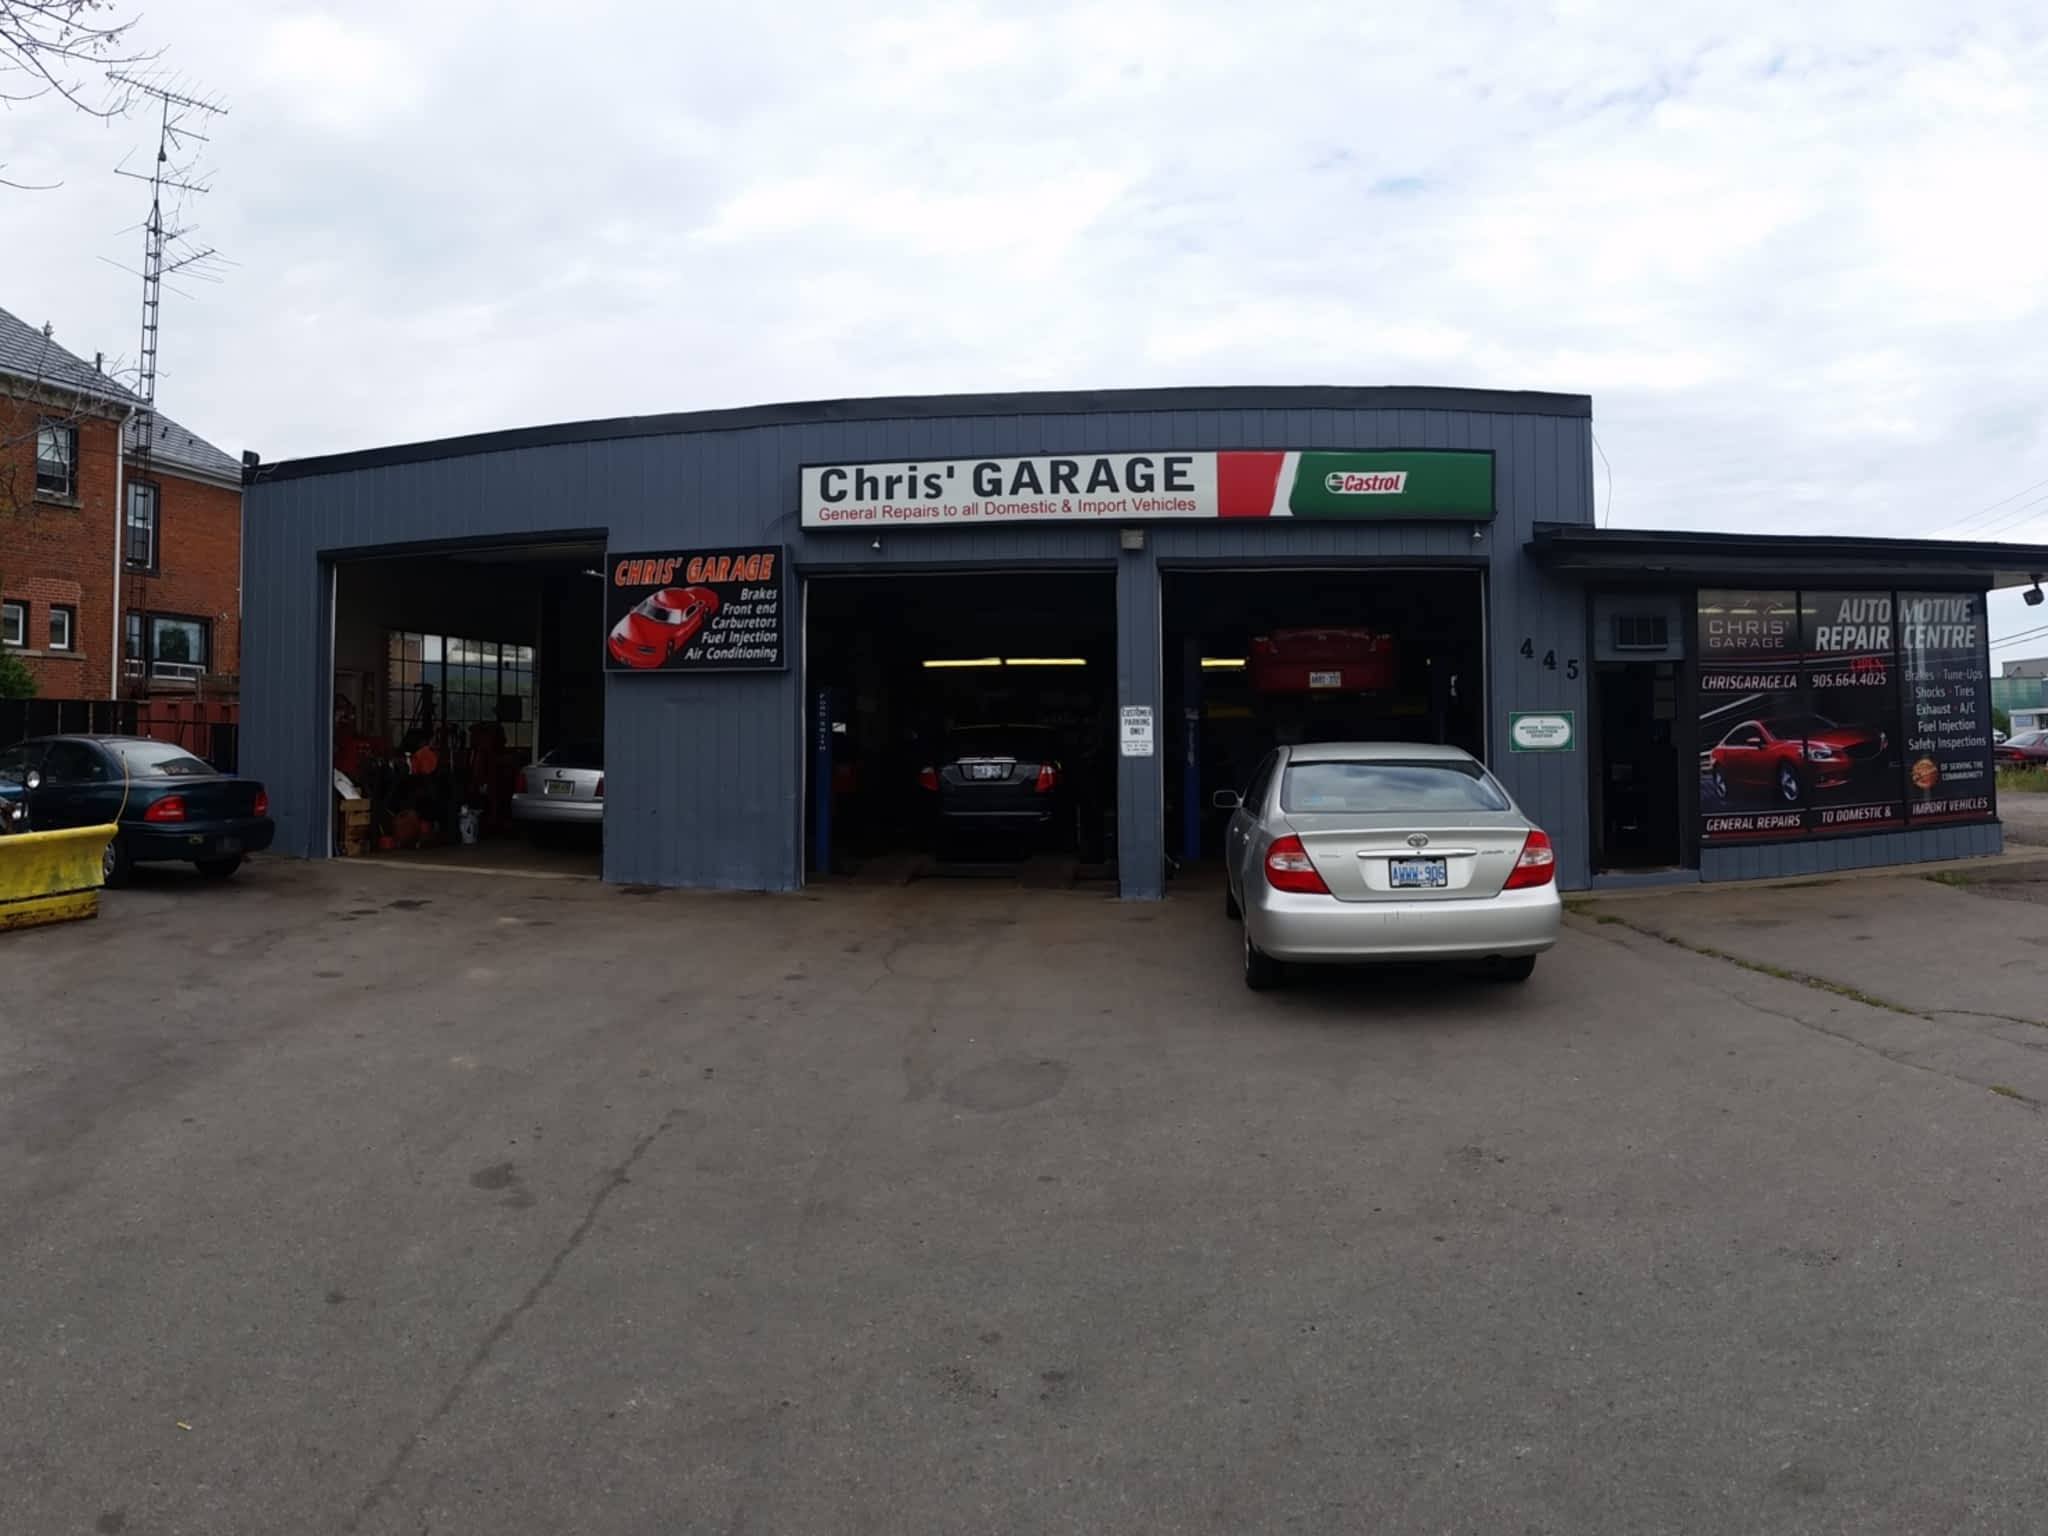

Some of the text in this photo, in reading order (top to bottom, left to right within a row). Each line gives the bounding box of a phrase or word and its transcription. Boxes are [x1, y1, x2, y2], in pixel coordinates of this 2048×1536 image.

[820, 456, 1195, 503] Chris' GARAGE
[1344, 474, 1401, 492] Castrol
[819, 497, 1196, 521] General Repairs to all Domestic & Import Vehicles
[615, 553, 775, 586] CHRIS' GARAGE
[740, 587, 778, 601] Brakes
[722, 602, 777, 615] Front end
[1837, 598, 1891, 624] AUTO
[711, 617, 777, 629] Carburetors
[1709, 620, 1790, 635] CHRIS'
[701, 629, 778, 645] Fuel Injection
[1709, 637, 1784, 649] GARAGE
[1816, 625, 1976, 651] REPAIR CENTRE
[684, 646, 778, 662] Air Conditioning
[1520, 638, 1579, 680] 445
[1702, 675, 1798, 689] CHRISGARAGE.CA
[1812, 672, 1887, 688] 905.664.4025
[1904, 668, 1983, 682] Brakes Tune-Ups
[1915, 685, 1975, 699] Shocks Tires
[1916, 702, 1976, 716] Exhaust A/C
[1918, 719, 1976, 734] Fuel Injection
[1908, 736, 1987, 752] Safety Inspections
[1913, 797, 1988, 815] IMPORT VEHICLES
[1822, 806, 1892, 823] TO DOMESTIC &
[1706, 815, 1801, 832] GENERAL REPAIRS
